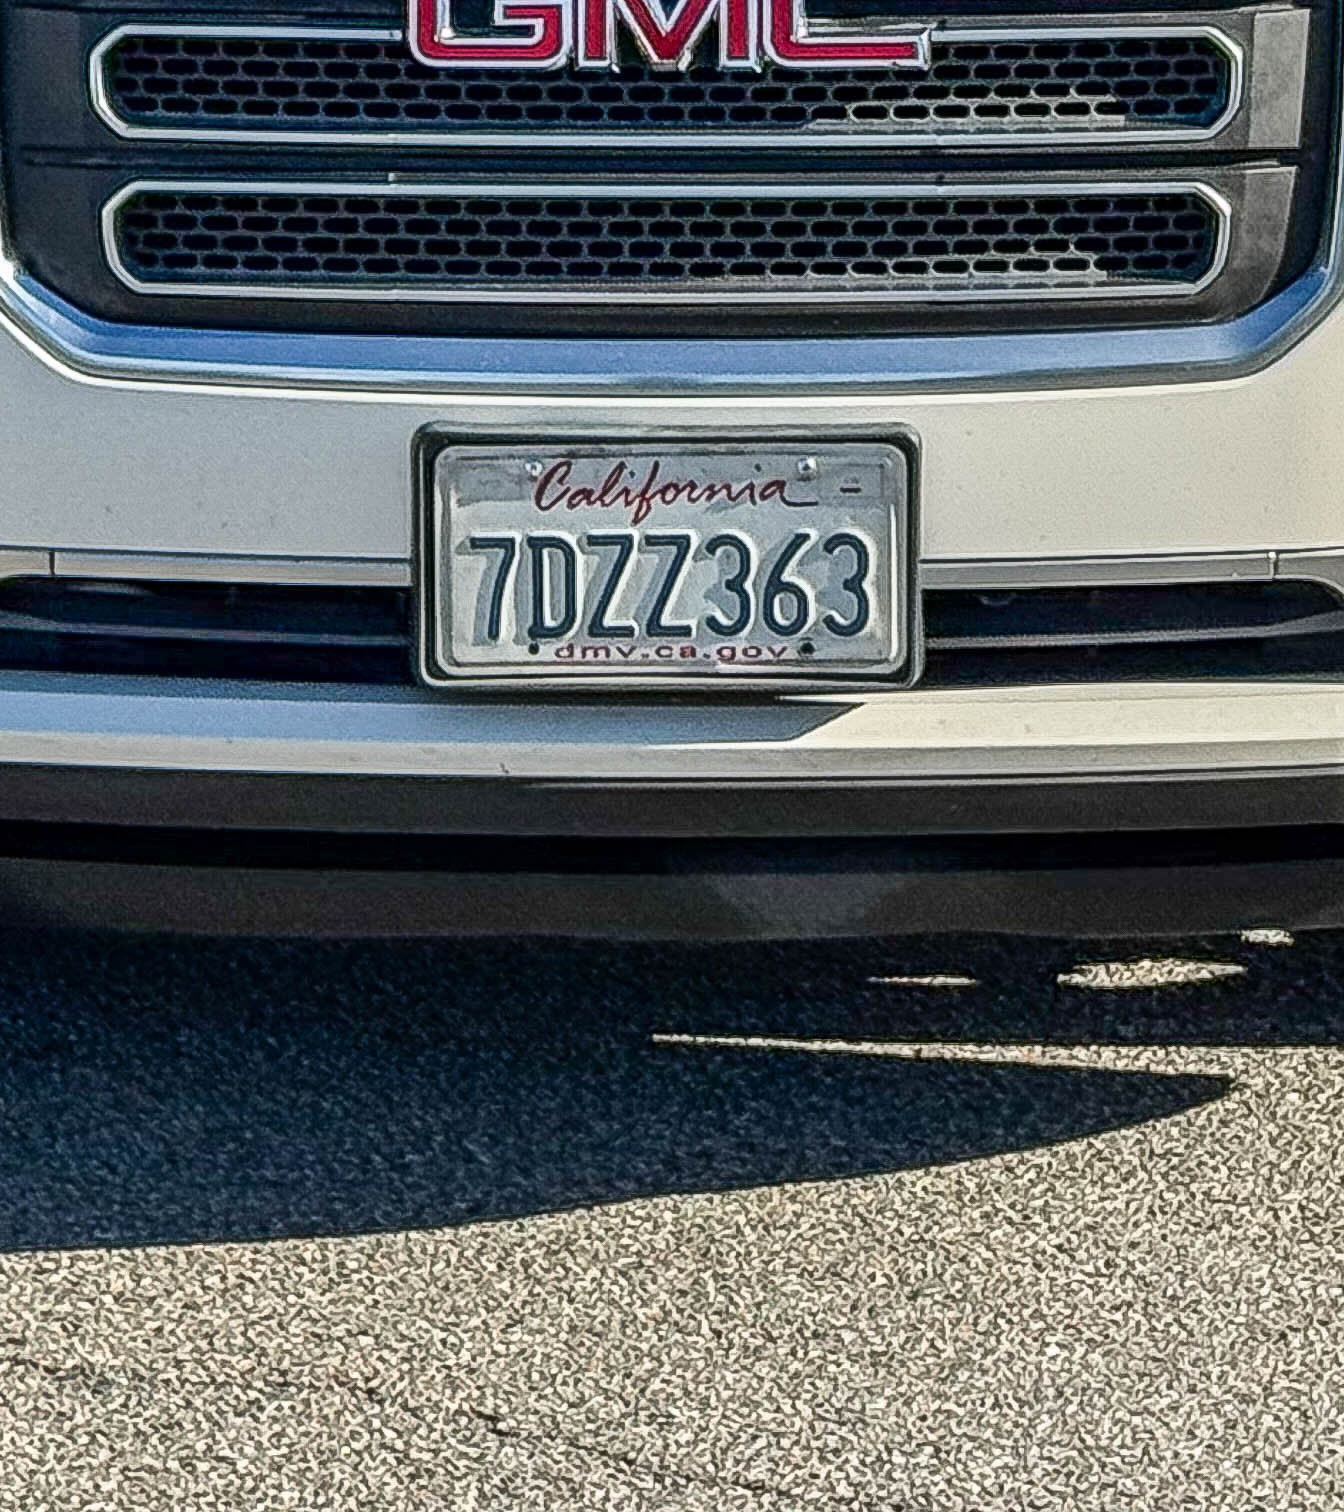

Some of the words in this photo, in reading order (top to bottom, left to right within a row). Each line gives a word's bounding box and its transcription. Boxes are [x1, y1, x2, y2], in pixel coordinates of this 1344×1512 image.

[533, 459, 819, 526] California
[468, 533, 872, 638] 7DZZ363
[553, 641, 789, 662] dmv.ca.gov
